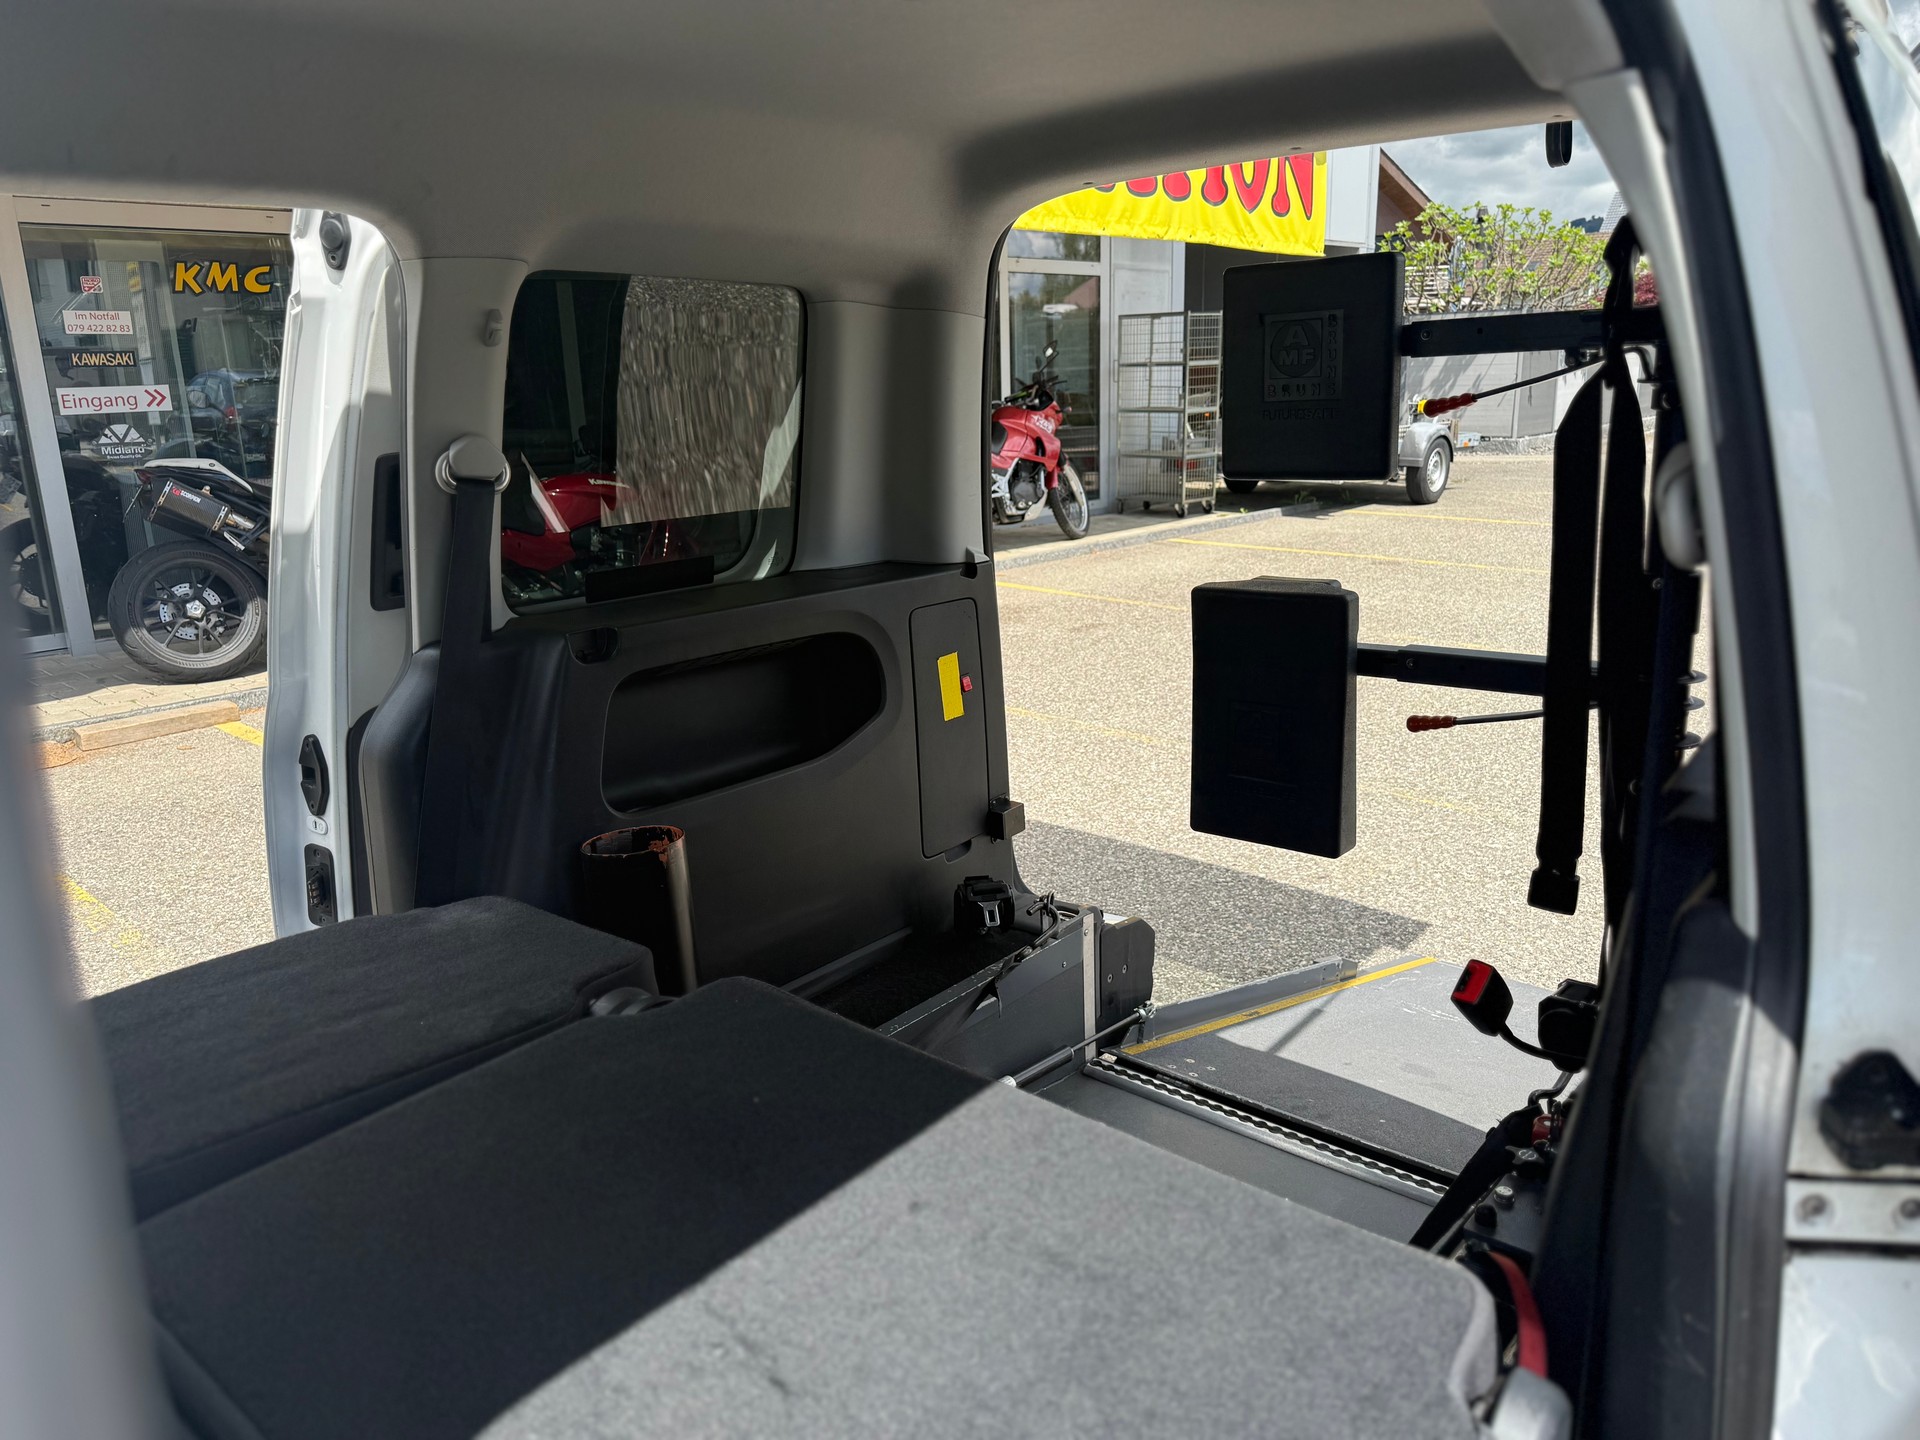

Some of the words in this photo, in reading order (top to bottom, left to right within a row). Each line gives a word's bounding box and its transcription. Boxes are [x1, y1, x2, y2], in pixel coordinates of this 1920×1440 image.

[174, 260, 272, 295] KMC
[74, 312, 87, 320] Im
[89, 312, 120, 321] Notfall
[67, 323, 85, 332] 079
[87, 324, 104, 332] 422
[106, 324, 118, 333] 82
[119, 324, 131, 333] 83
[71, 352, 134, 366] KAWASAKI
[61, 393, 138, 412] Eingang
[101, 444, 145, 455] Midland
